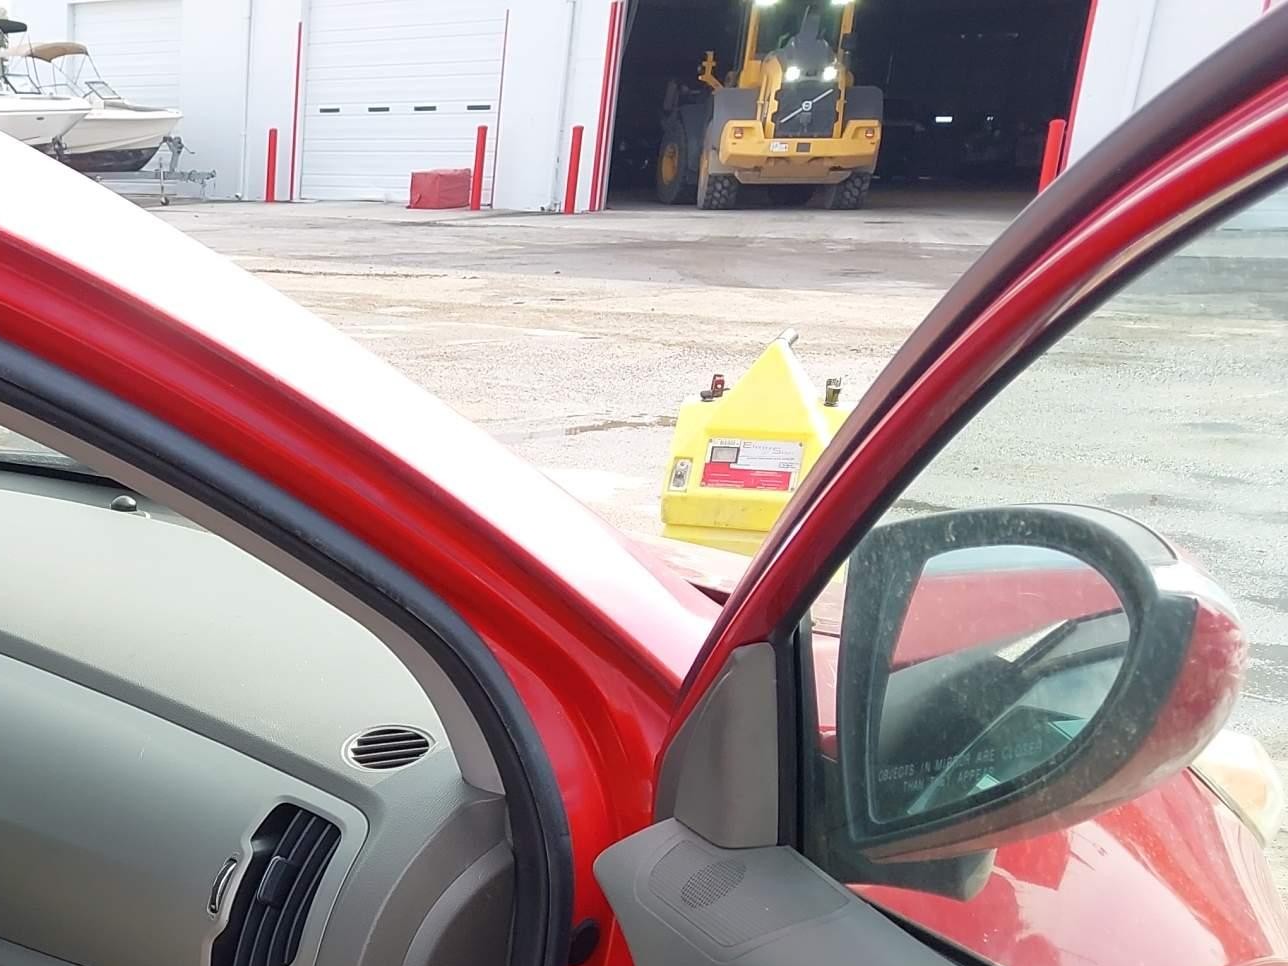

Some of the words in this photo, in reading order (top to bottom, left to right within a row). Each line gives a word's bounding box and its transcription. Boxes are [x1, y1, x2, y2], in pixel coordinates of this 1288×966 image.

[878, 763, 915, 782] OBJECTS
[920, 760, 931, 772] IN
[976, 748, 995, 762] ARE
